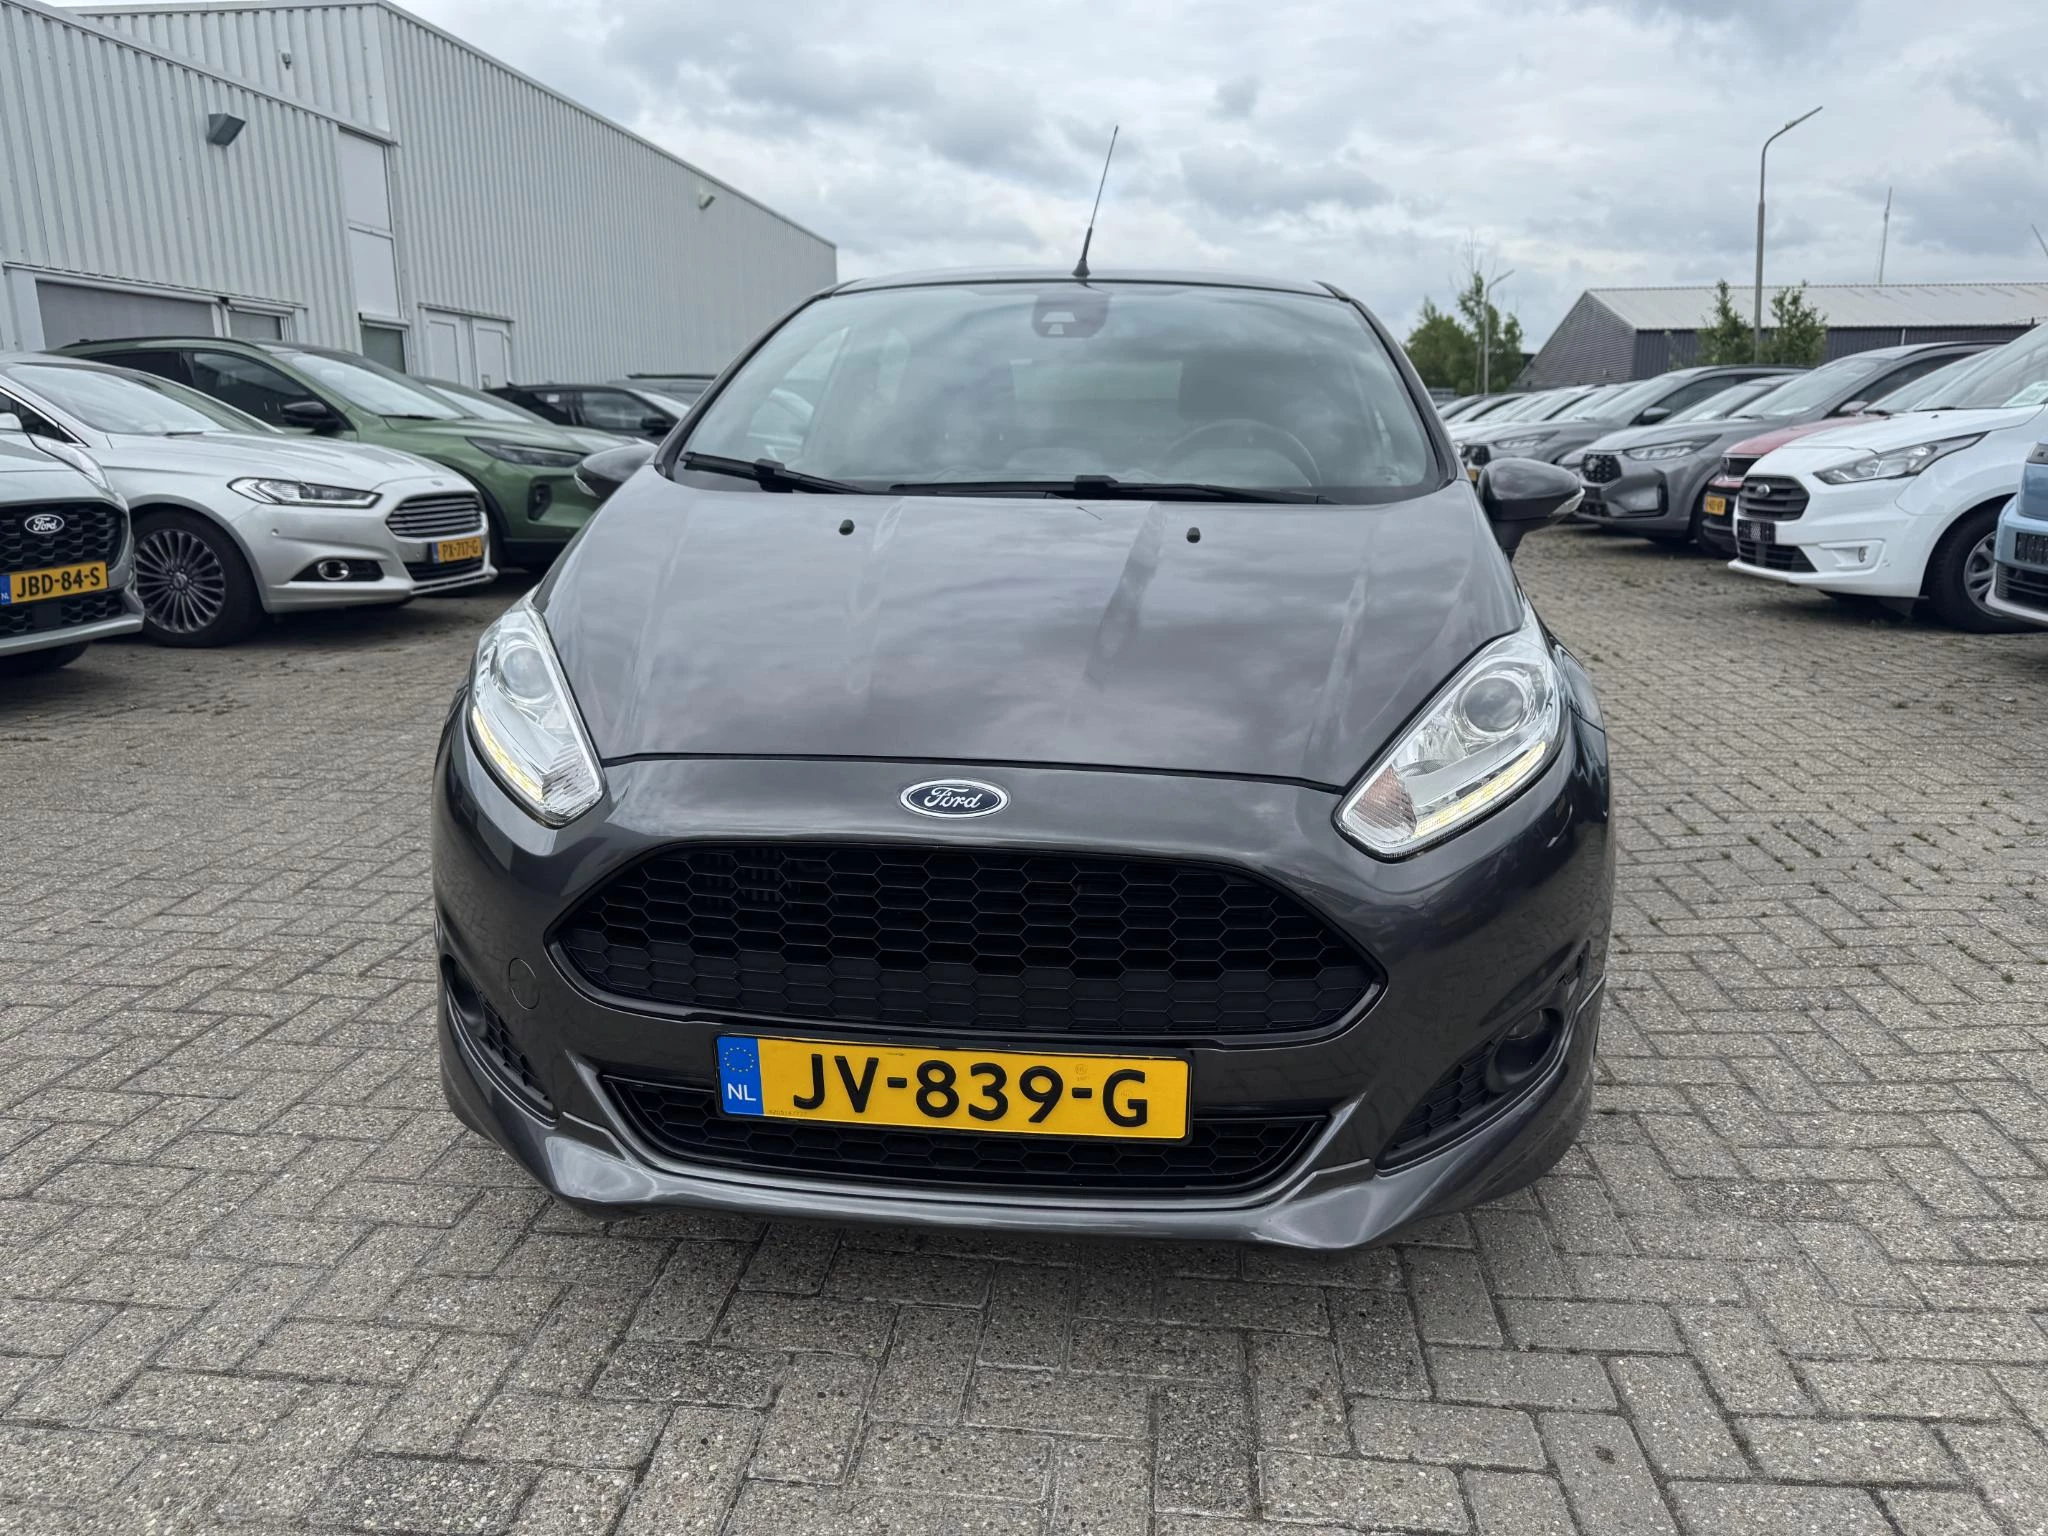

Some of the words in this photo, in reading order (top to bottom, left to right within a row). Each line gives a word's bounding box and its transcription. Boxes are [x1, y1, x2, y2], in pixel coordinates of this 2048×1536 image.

[33, 517, 57, 531] Ford
[17, 567, 101, 599] JBD-84-S
[924, 786, 983, 808] Ford
[727, 1083, 757, 1102] NL
[793, 1053, 1148, 1128] JV-839-G
